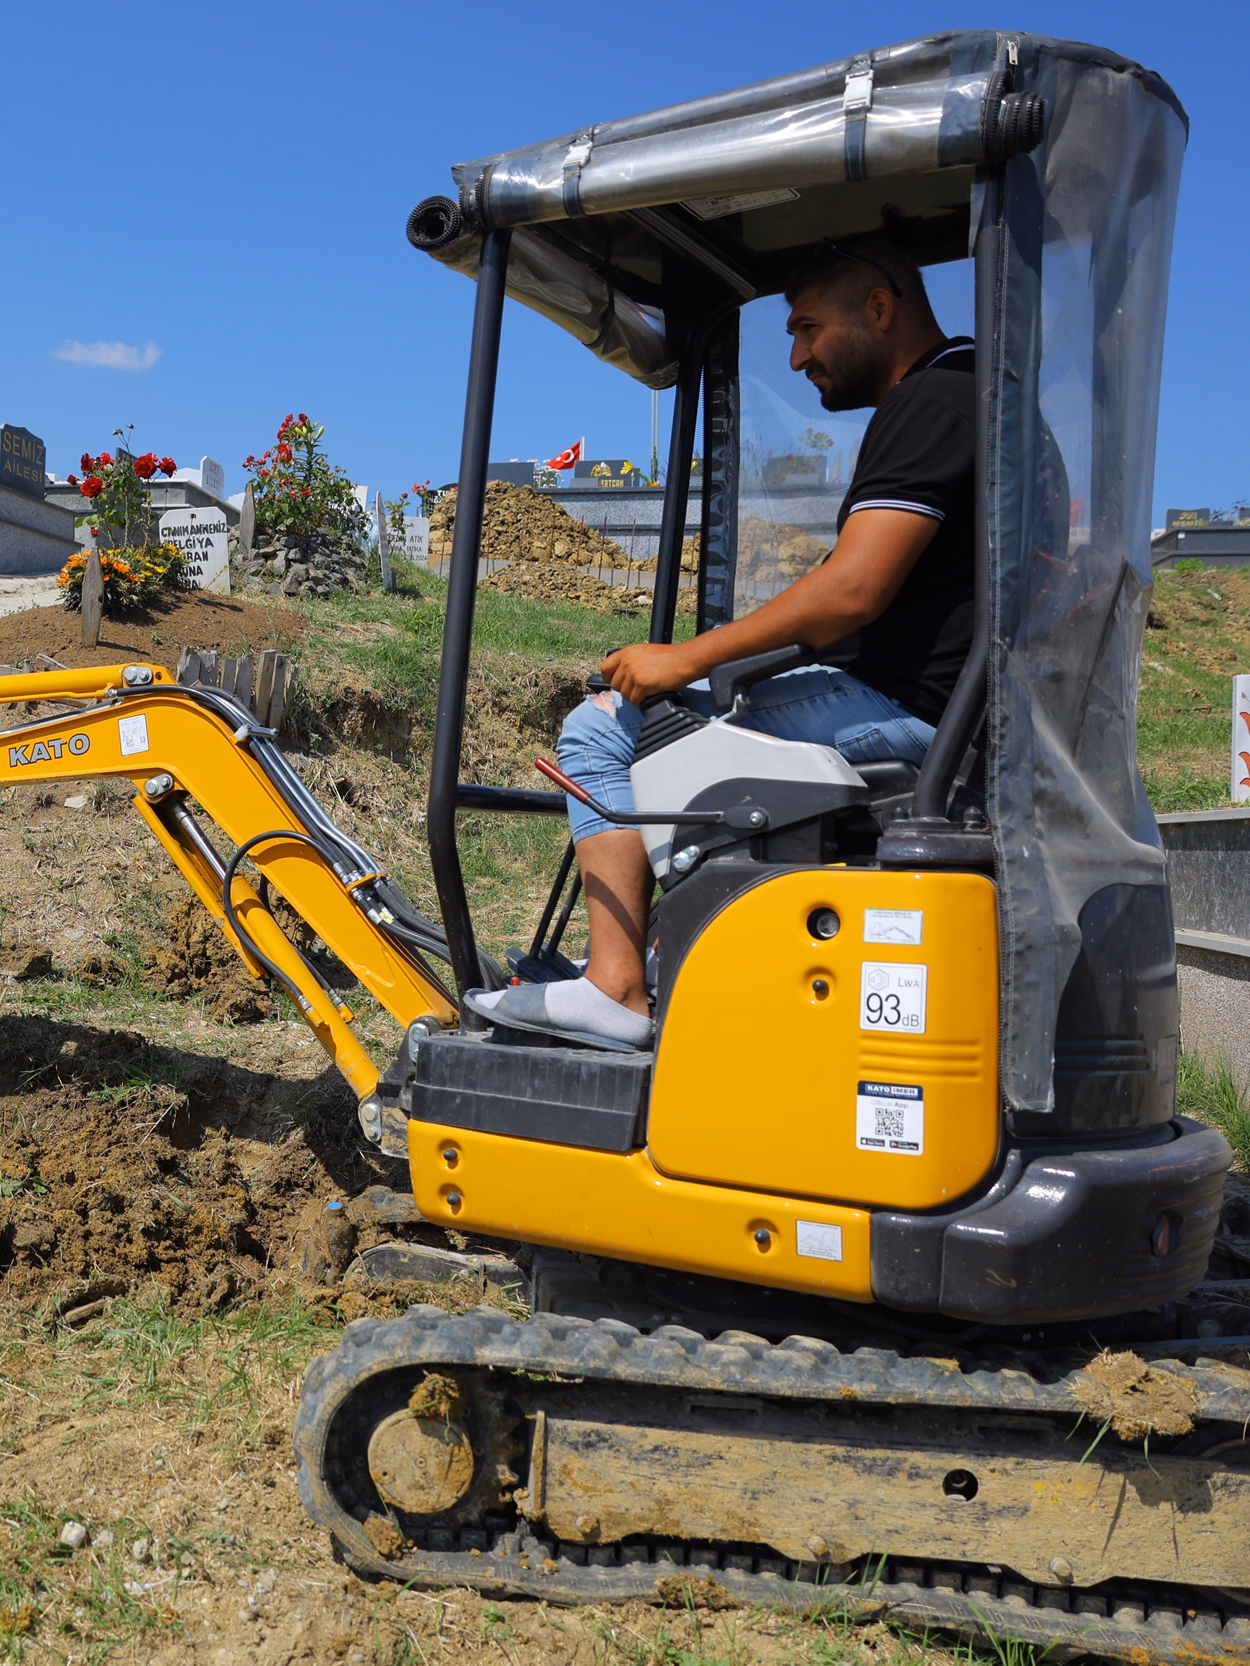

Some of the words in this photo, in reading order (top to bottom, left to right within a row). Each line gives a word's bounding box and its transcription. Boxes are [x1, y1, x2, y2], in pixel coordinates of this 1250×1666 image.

[3, 431, 44, 466] SEMİZ
[598, 479, 625, 488] ERTCAN
[8, 733, 91, 768] KATO
[865, 991, 901, 1026] 93
[901, 1014, 920, 1028] dB
[866, 1084, 891, 1094] KATO
